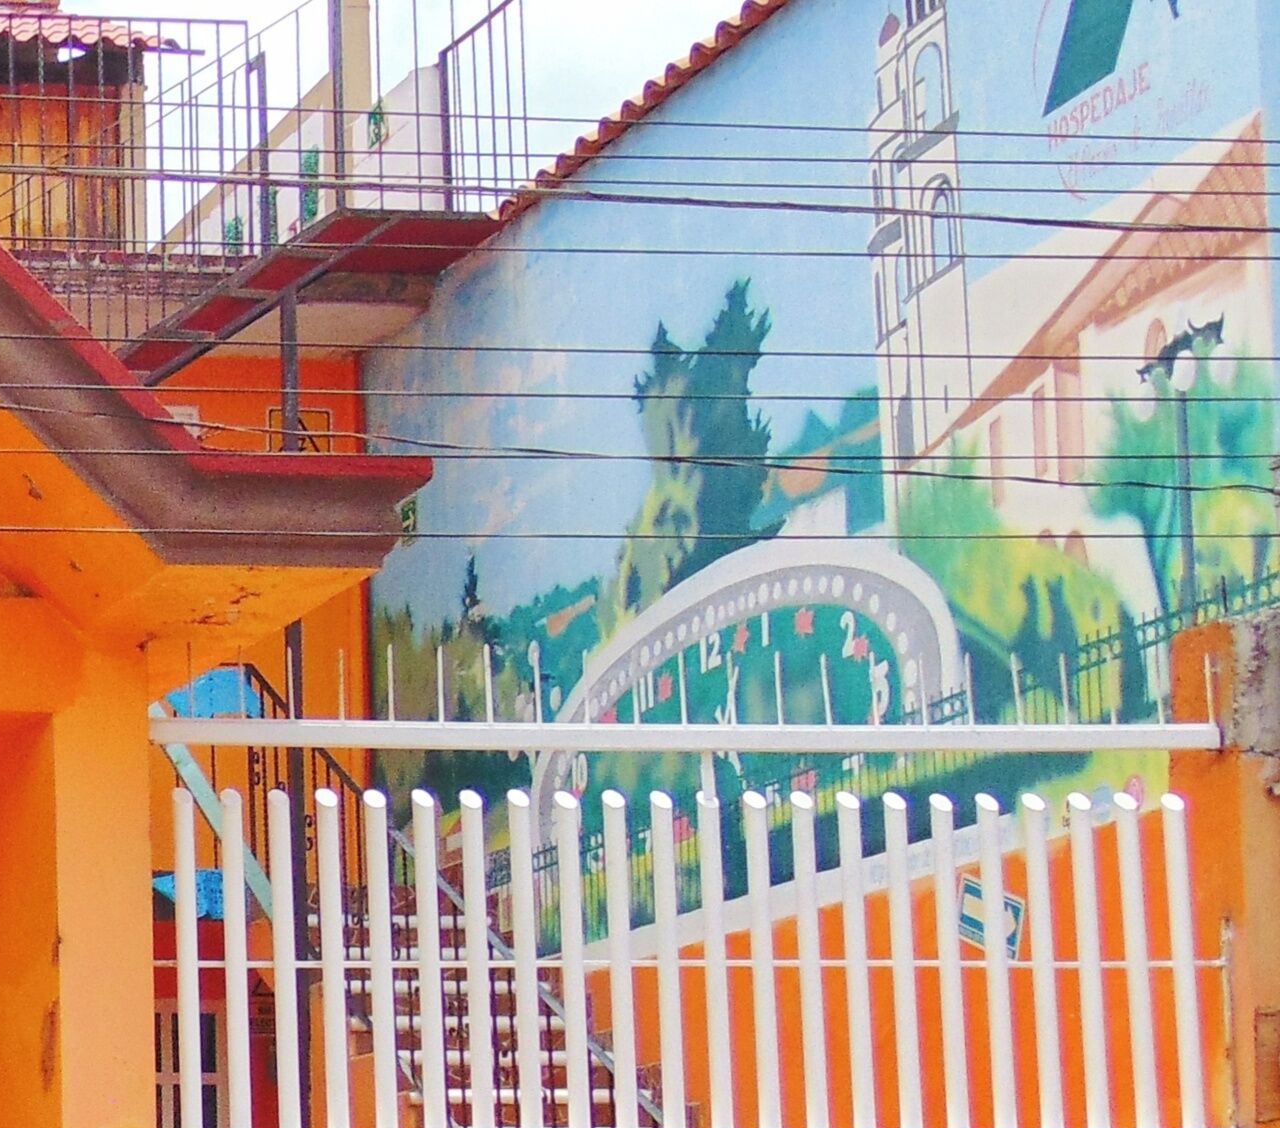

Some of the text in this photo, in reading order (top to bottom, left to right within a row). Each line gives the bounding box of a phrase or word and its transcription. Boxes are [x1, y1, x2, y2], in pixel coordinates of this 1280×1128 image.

[1046, 61, 1150, 152] HOSPEDAJE
[699, 631, 722, 674] 12
[840, 611, 855, 659] 2
